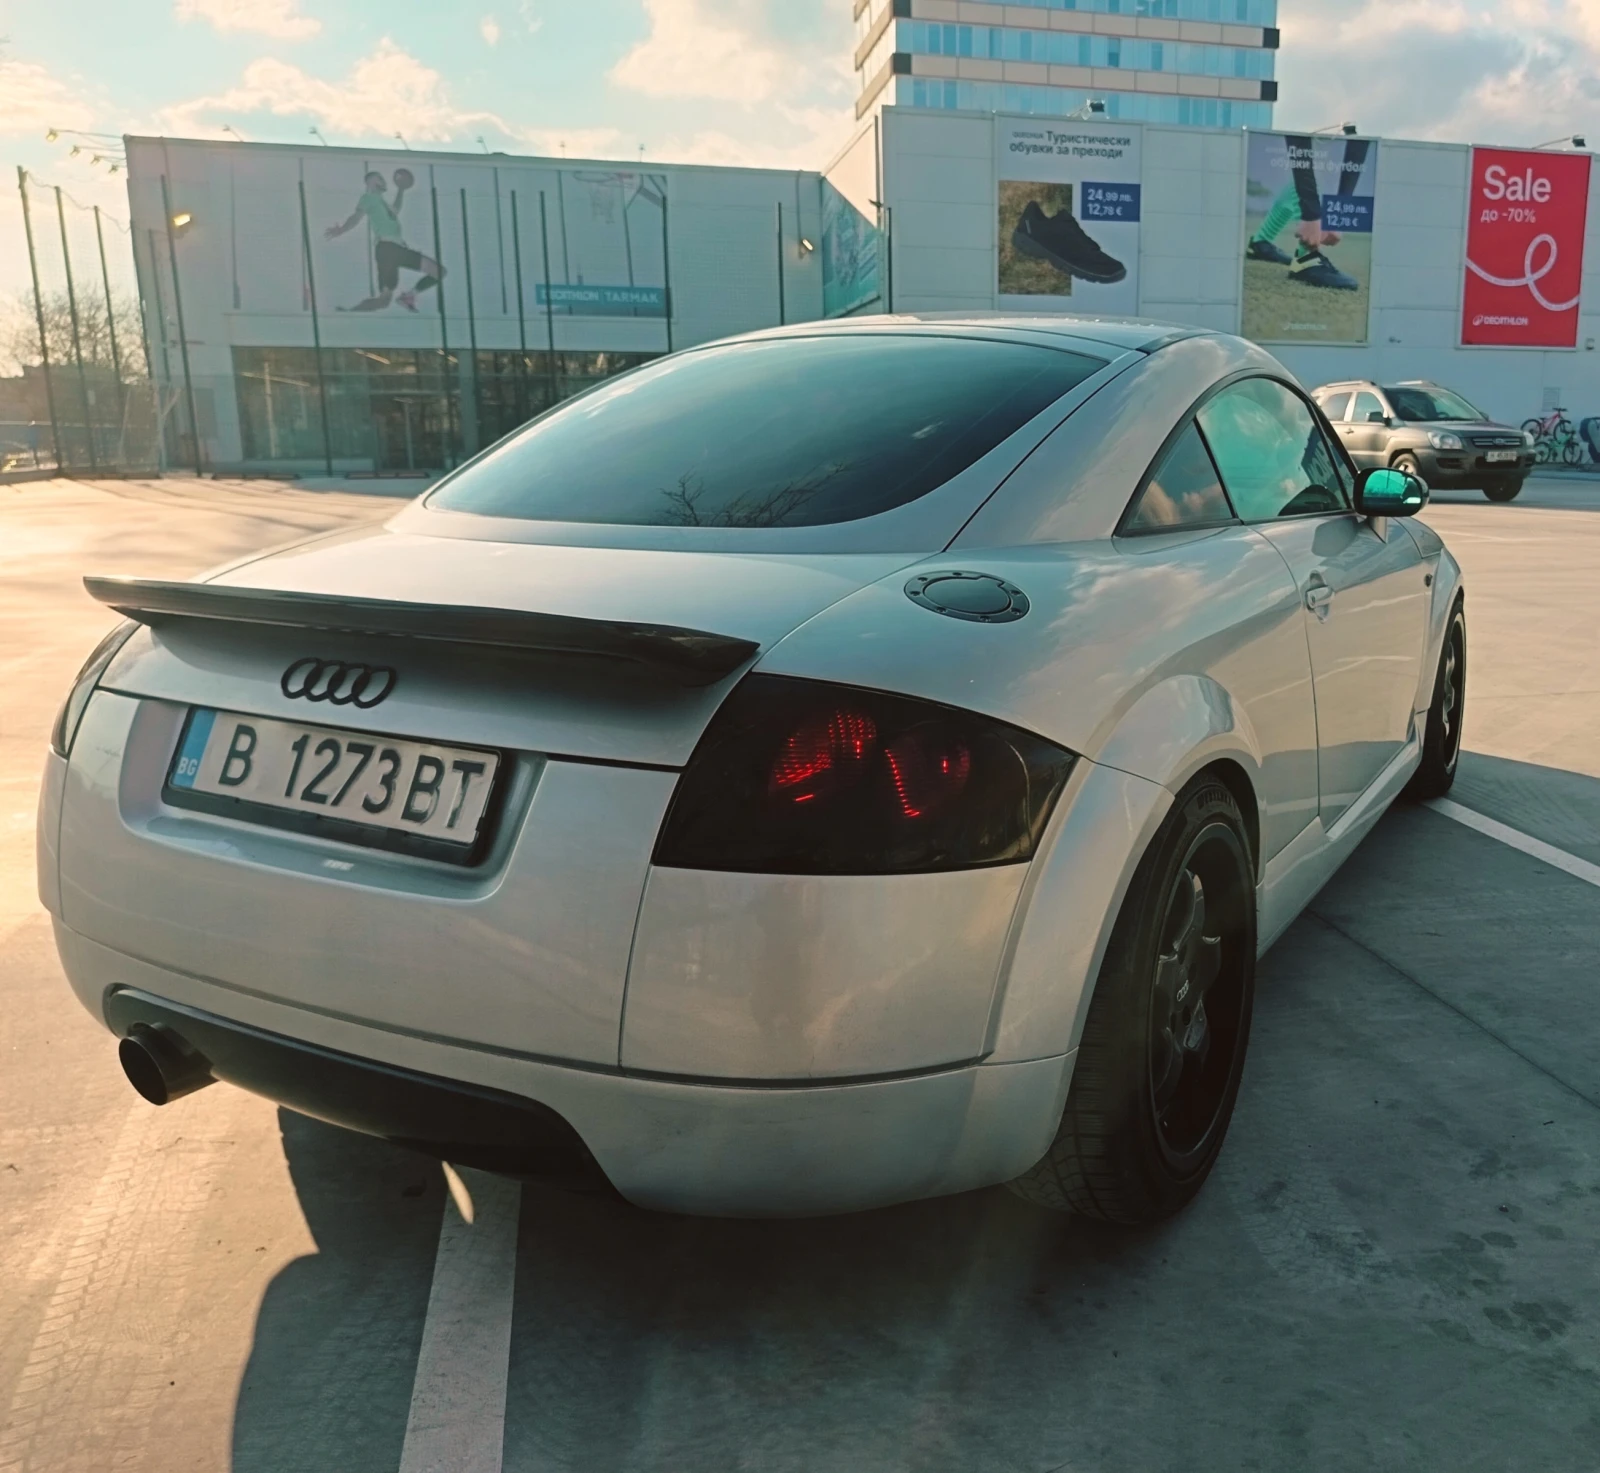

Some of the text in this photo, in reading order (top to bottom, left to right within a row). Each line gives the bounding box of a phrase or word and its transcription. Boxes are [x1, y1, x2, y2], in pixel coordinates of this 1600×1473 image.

[1046, 130, 1131, 146] Туристически
[1009, 142, 1123, 158] обувки за преходи
[1483, 165, 1551, 203] Sale
[1087, 188, 1119, 202] 24,99
[1115, 206, 1124, 216] €
[1481, 207, 1537, 223] до -70%
[603, 290, 659, 303] TARMAK
[1484, 315, 1528, 326] DECATHLON
[177, 756, 198, 777] BG
[284, 733, 401, 814] 1273
